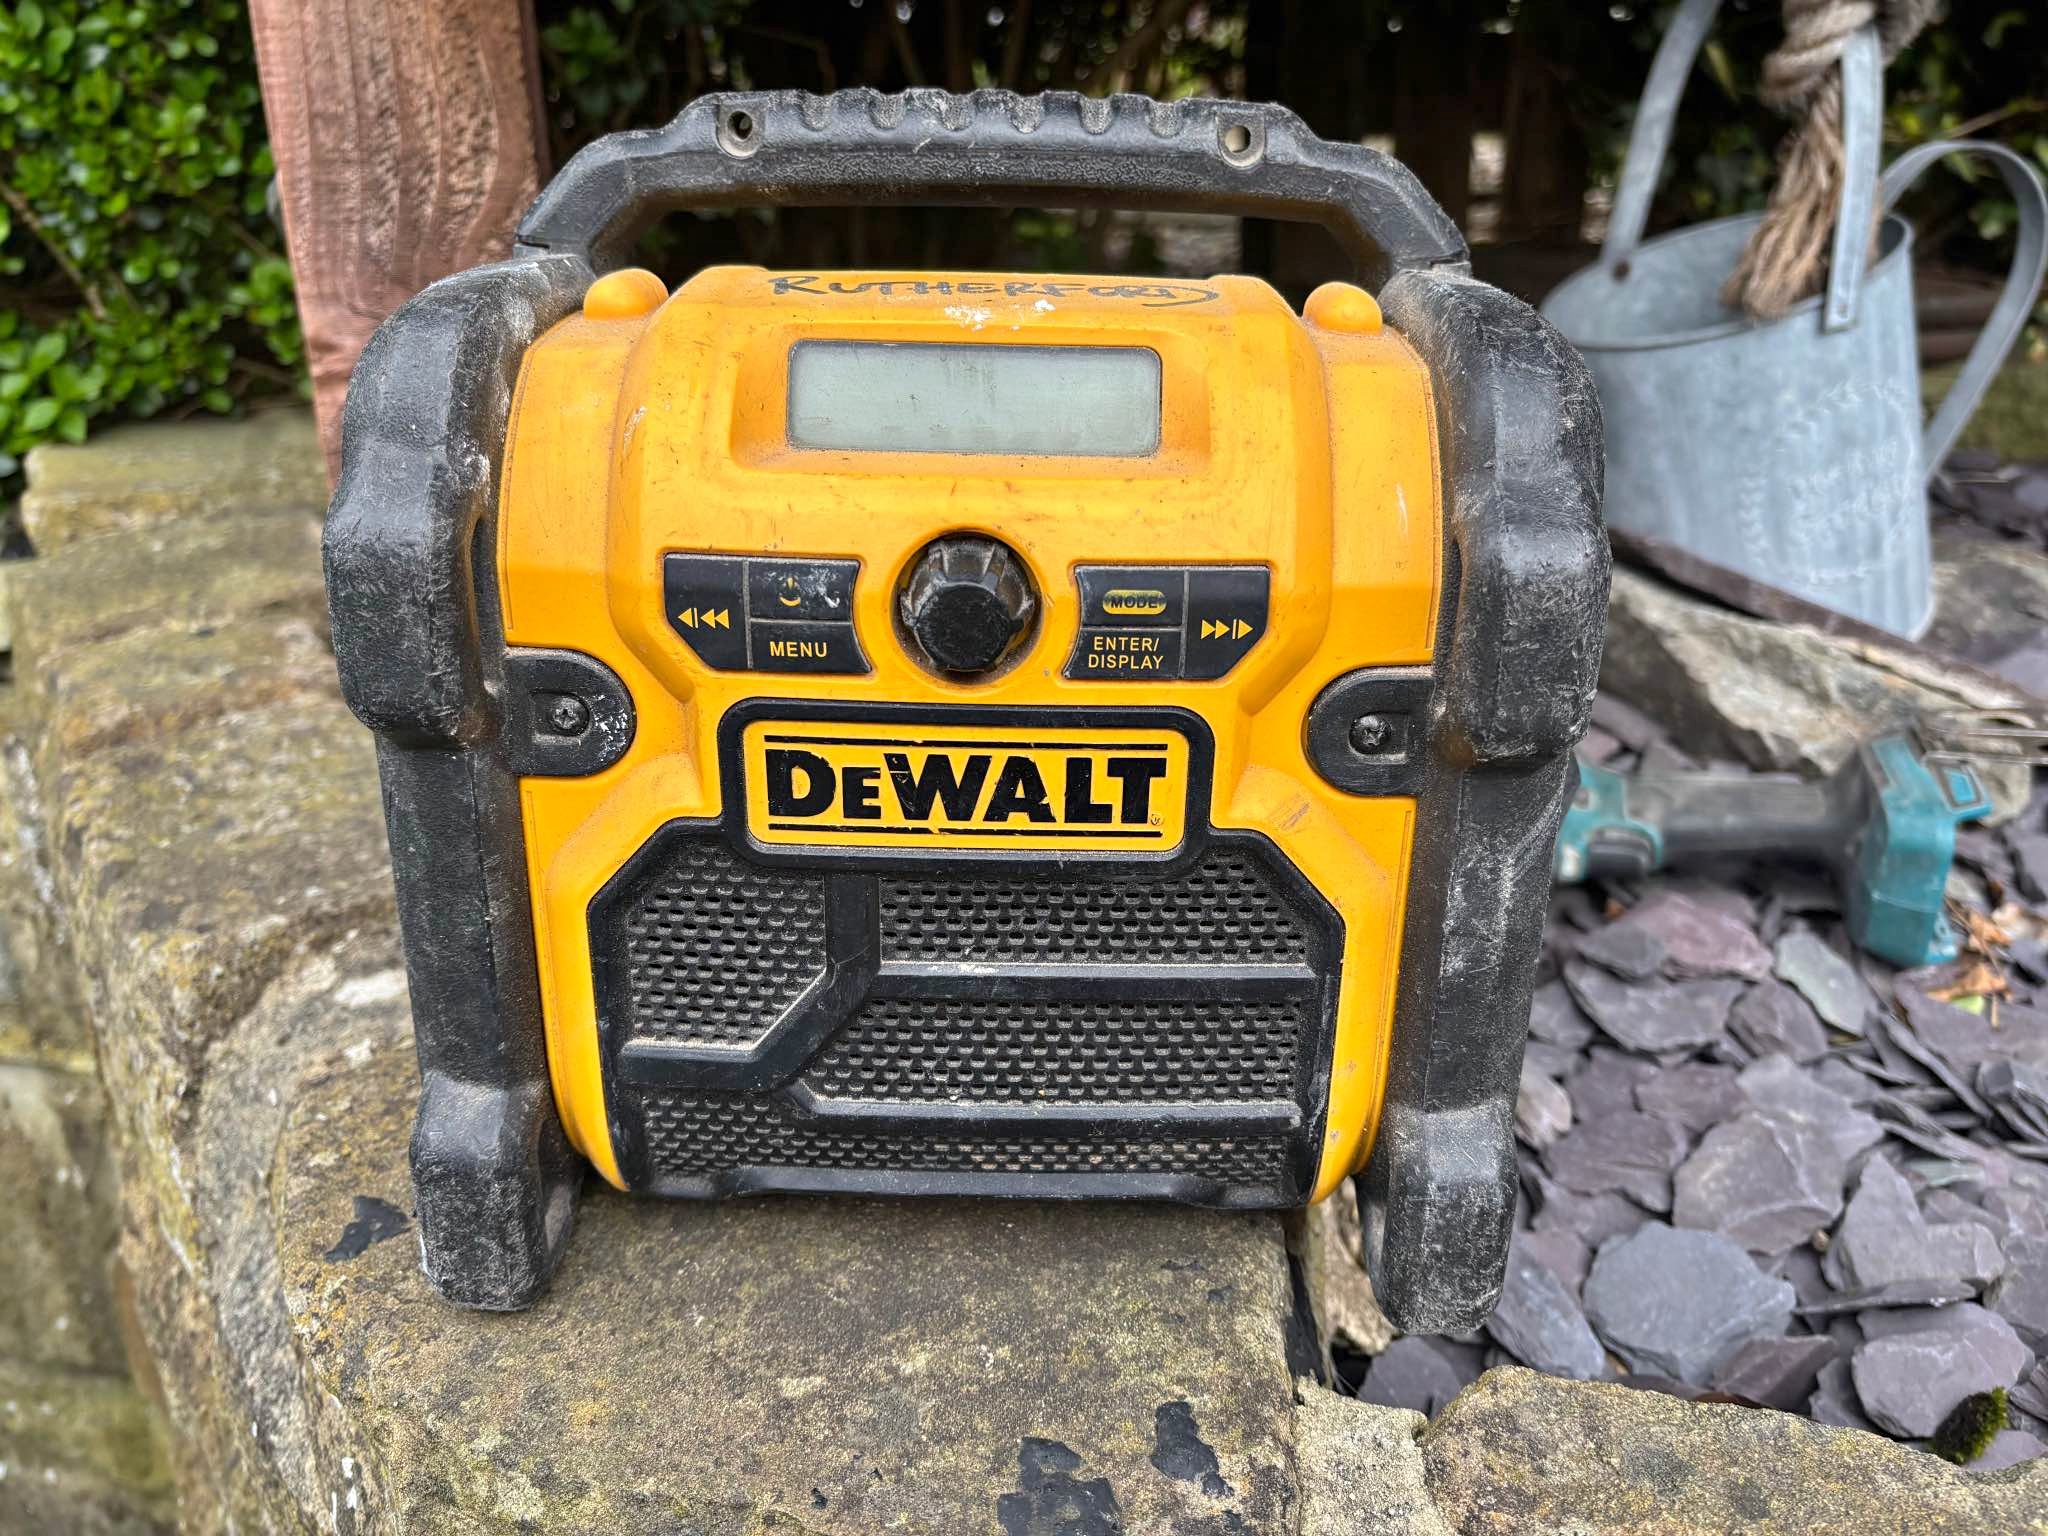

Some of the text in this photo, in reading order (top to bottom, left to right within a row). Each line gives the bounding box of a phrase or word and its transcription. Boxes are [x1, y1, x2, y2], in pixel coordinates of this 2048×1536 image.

[1110, 596, 1160, 609] MODE
[769, 641, 827, 658] MENU
[1093, 636, 1160, 652] ENTER/
[1088, 654, 1164, 670] DISPLAY
